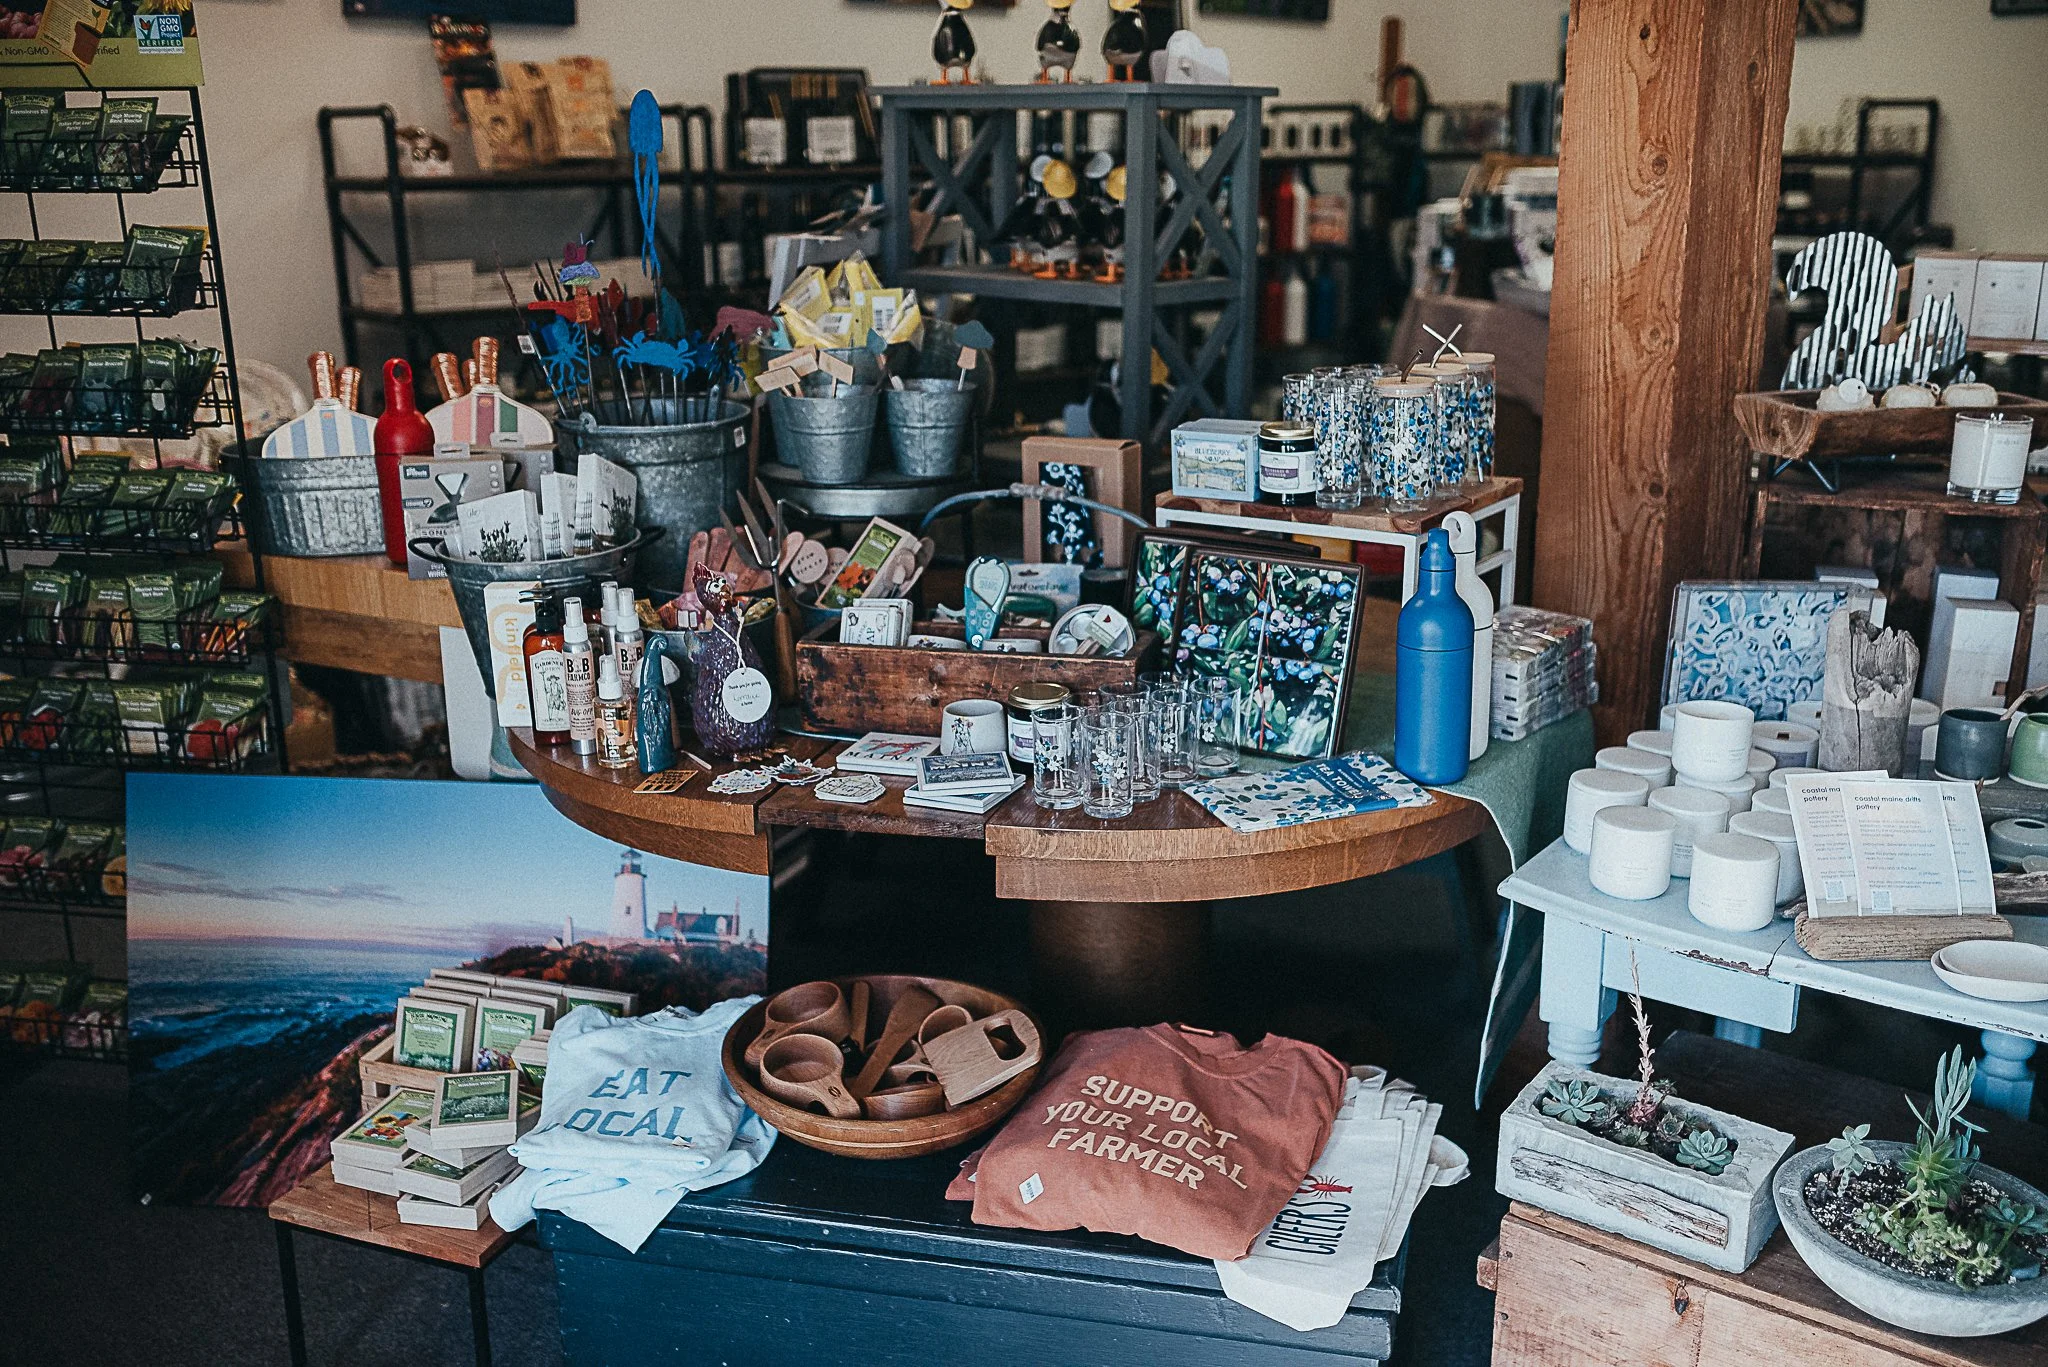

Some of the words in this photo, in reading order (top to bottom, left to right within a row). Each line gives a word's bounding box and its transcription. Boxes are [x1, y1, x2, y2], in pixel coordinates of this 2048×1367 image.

[159, 17, 178, 25] NON
[5, 47, 48, 56] Non-GMO
[96, 45, 120, 55] rified
[1194, 447, 1231, 456] BLUEBERRY
[504, 617, 523, 682] kinfield
[567, 672, 591, 682] FARMCO
[604, 708, 621, 759] kinfield
[845, 751, 918, 762] MAINE
[930, 758, 997, 771] MAINE
[1316, 763, 1335, 777] TEA
[1332, 775, 1364, 799] TOWEL
[1801, 786, 1828, 794] coastal
[587, 1067, 692, 1100] EAT
[1080, 1075, 1239, 1149] SUPPORT
[550, 1106, 693, 1143] OCAL
[1041, 1100, 1133, 1131] YOUR
[1138, 1123, 1248, 1190] LOCAL
[1046, 1128, 1205, 1190] FARMER
[1265, 1197, 1352, 1255] CHEERS
